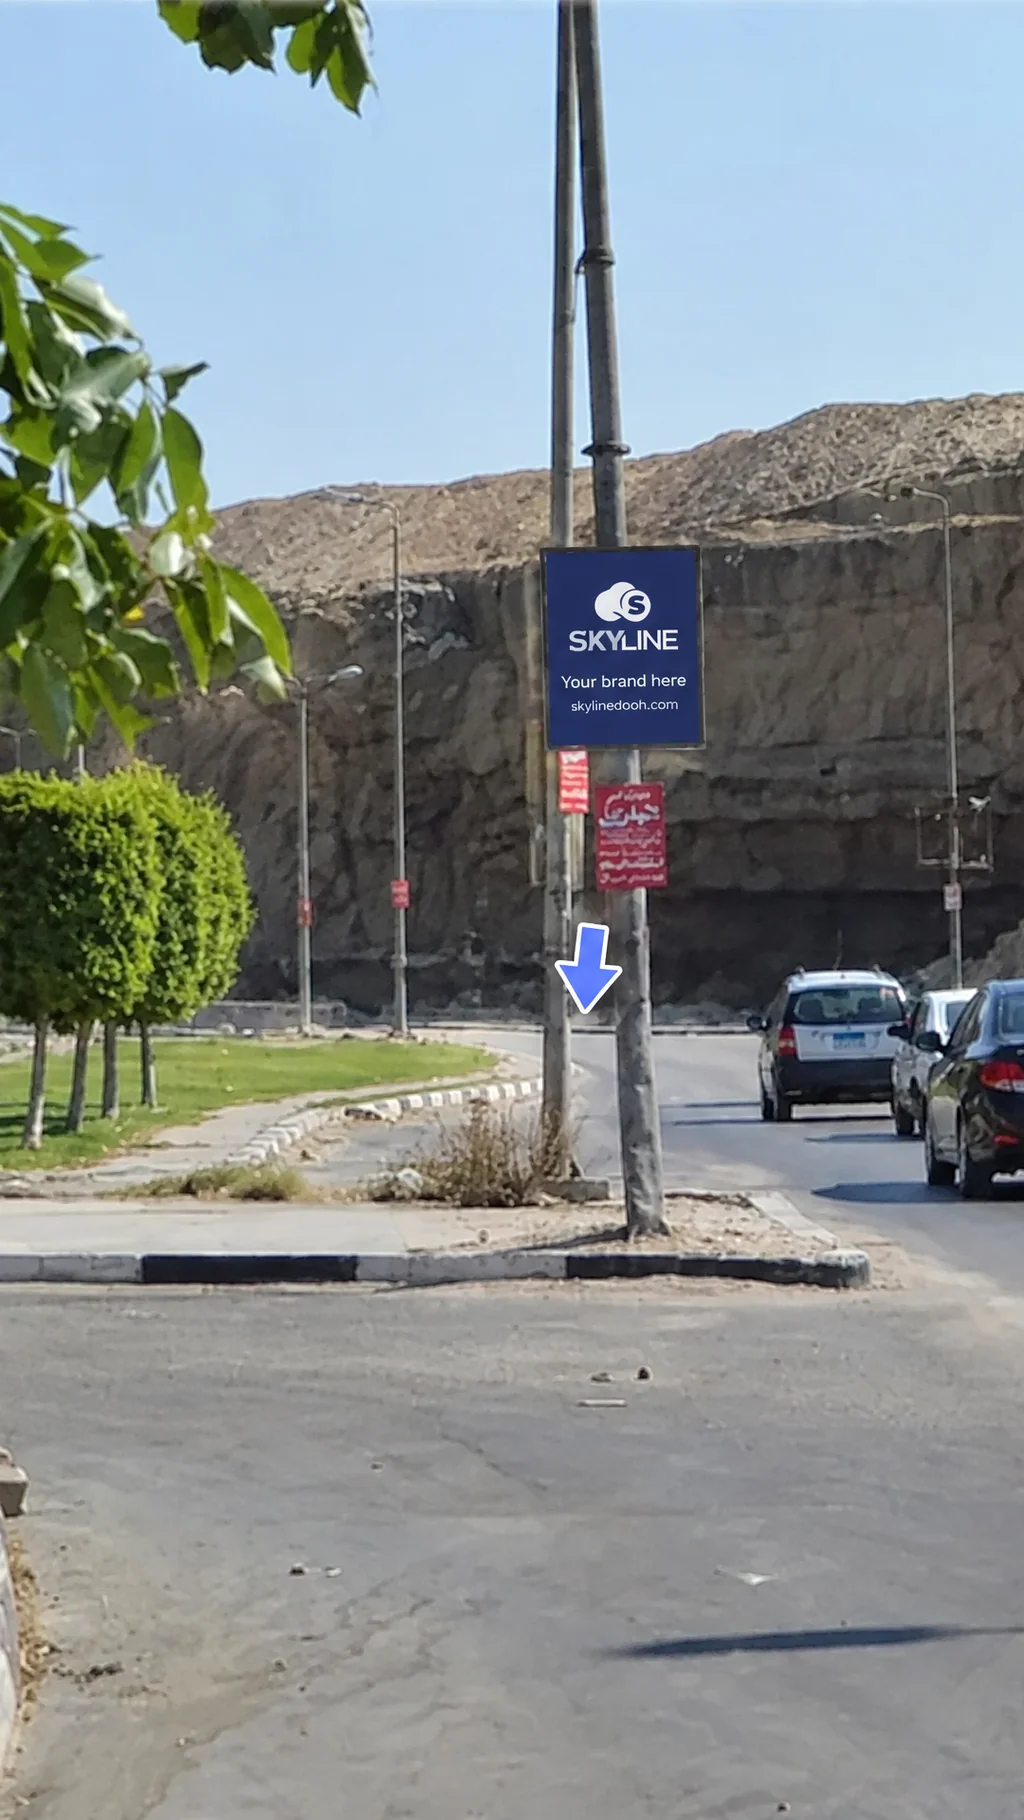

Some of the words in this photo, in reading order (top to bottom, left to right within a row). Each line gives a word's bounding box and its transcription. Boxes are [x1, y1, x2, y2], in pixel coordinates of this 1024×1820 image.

[569, 630, 679, 652] SKYLINE
[561, 675, 597, 689] Your
[602, 674, 647, 688] brand
[651, 674, 687, 687] here
[571, 699, 679, 714] skylinedooh.com
